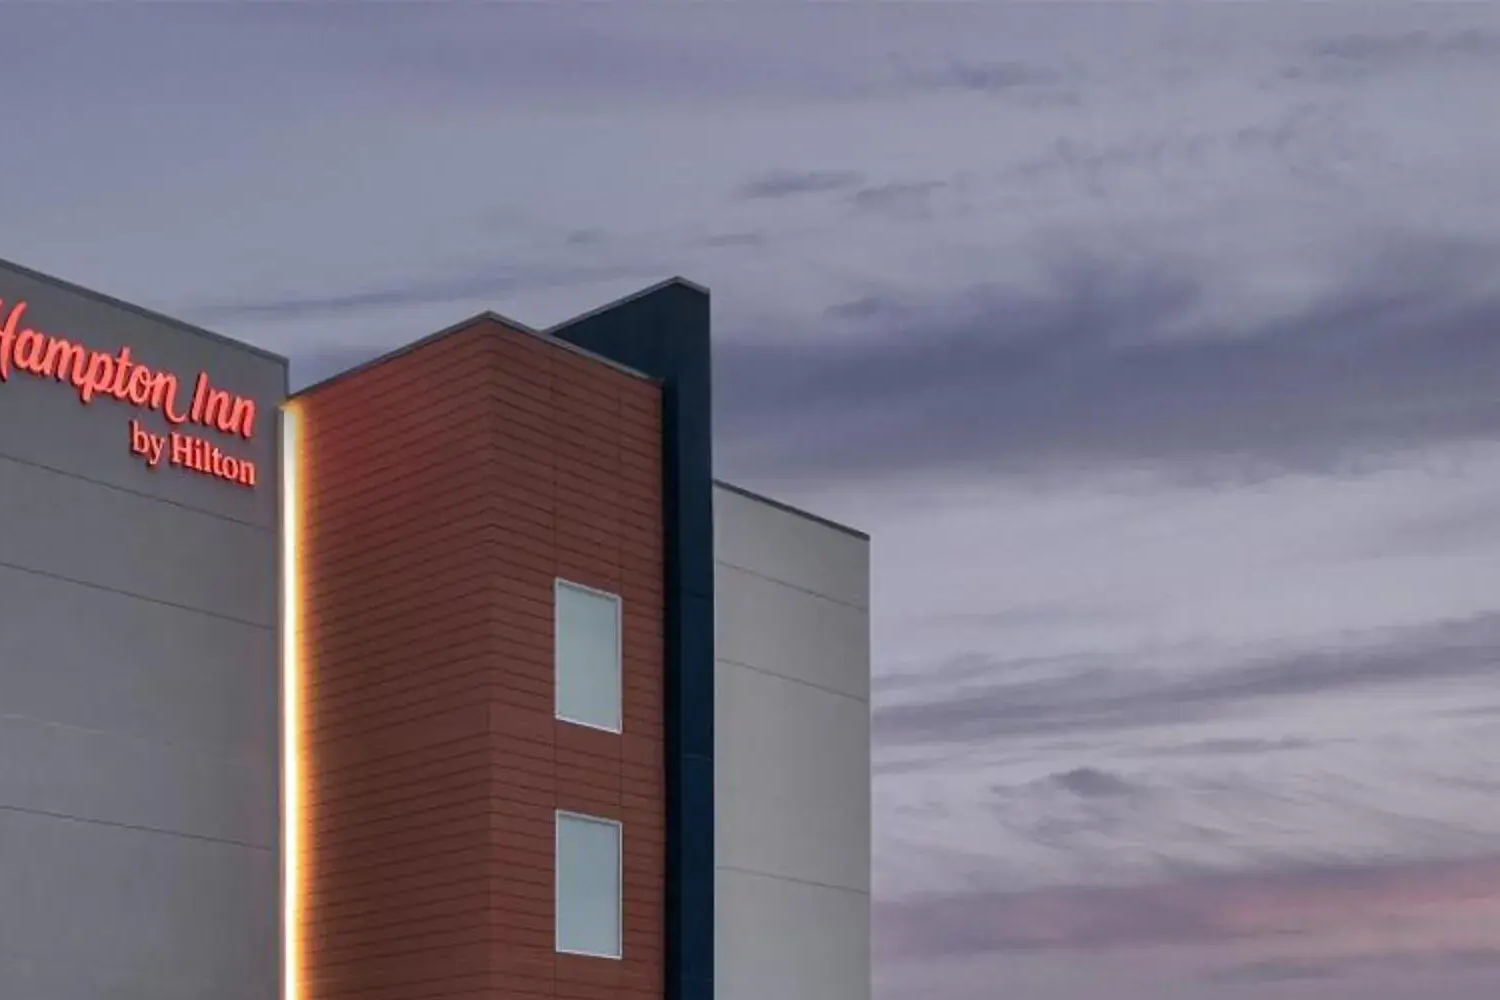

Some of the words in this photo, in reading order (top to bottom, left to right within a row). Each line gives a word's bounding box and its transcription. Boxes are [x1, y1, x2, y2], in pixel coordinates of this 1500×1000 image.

[191, 371, 255, 437] Inn
[131, 420, 164, 465] by
[170, 431, 256, 486] Hilton
